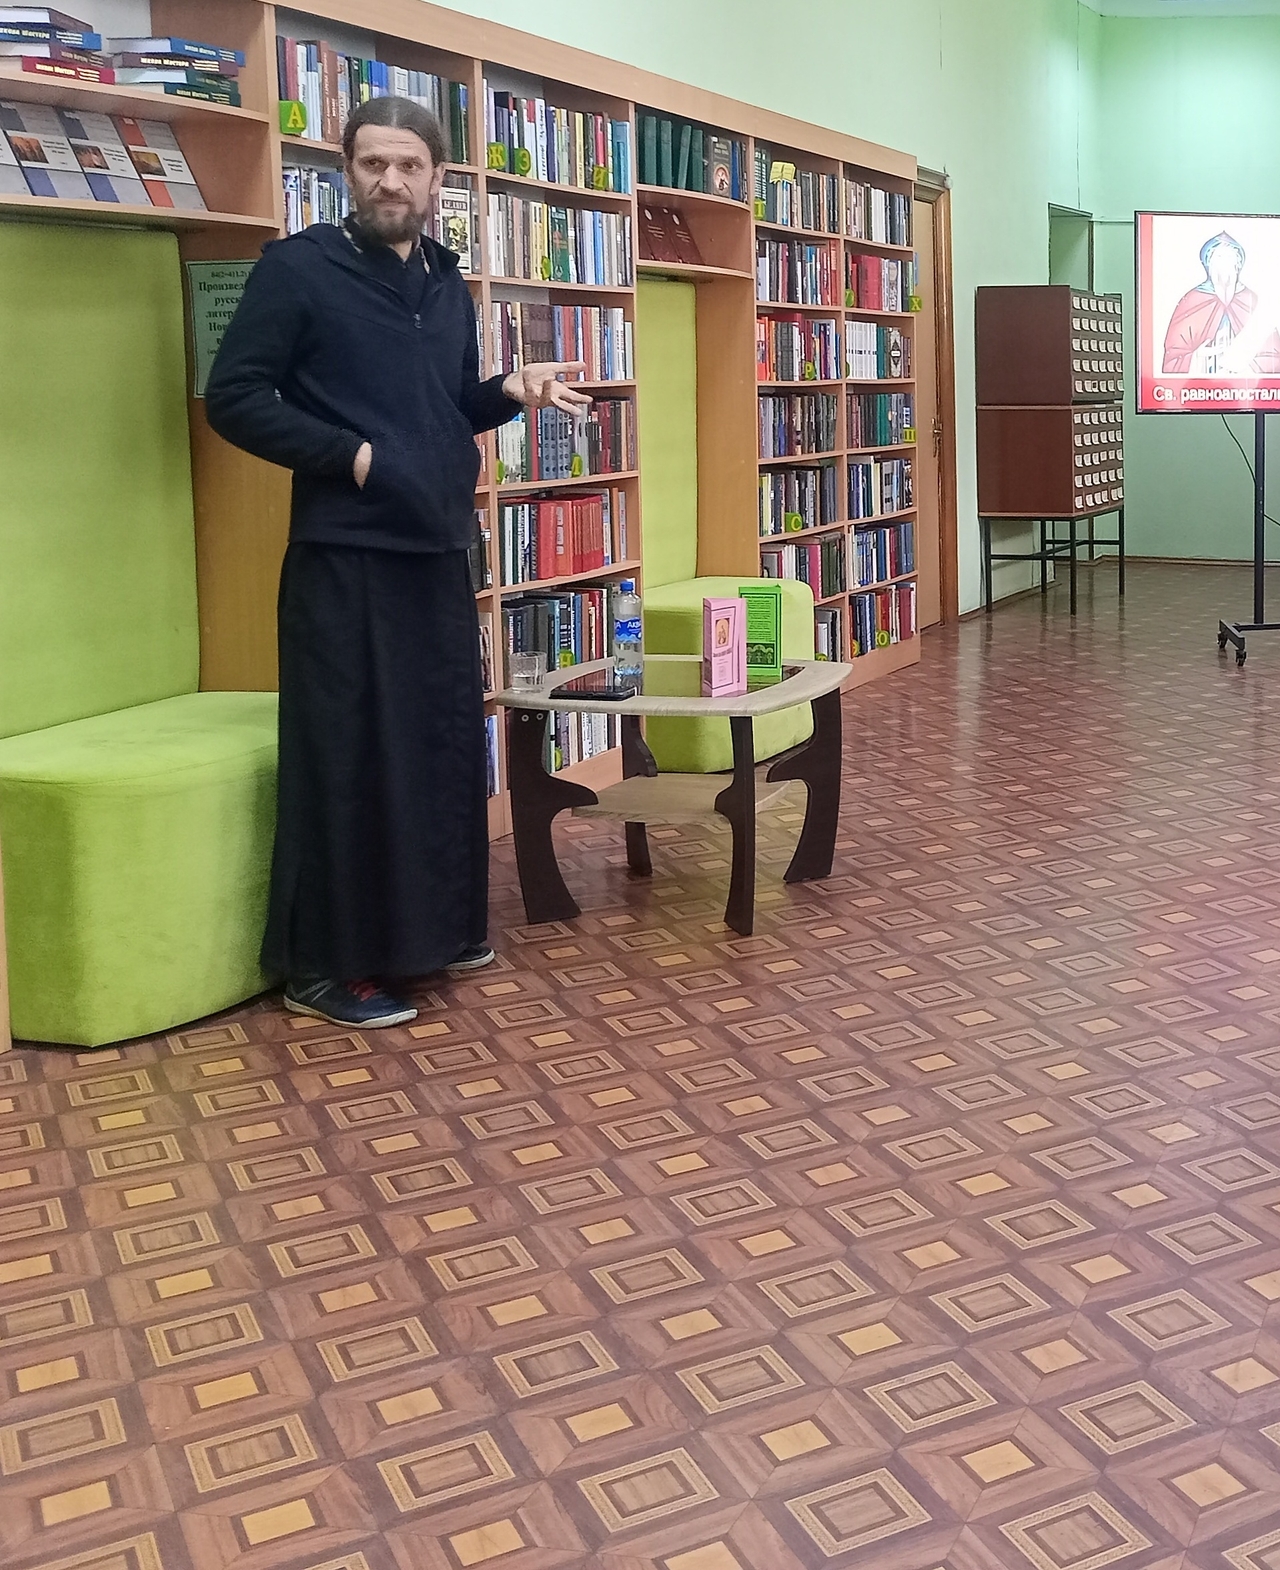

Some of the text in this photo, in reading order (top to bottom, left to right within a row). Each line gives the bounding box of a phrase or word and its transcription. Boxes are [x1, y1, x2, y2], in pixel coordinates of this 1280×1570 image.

[287, 103, 305, 129] А
[487, 146, 505, 167] Ж
[911, 297, 921, 312] Х
[805, 362, 812, 376] Р
[1153, 386, 1177, 401] Св.
[790, 514, 802, 531] С
